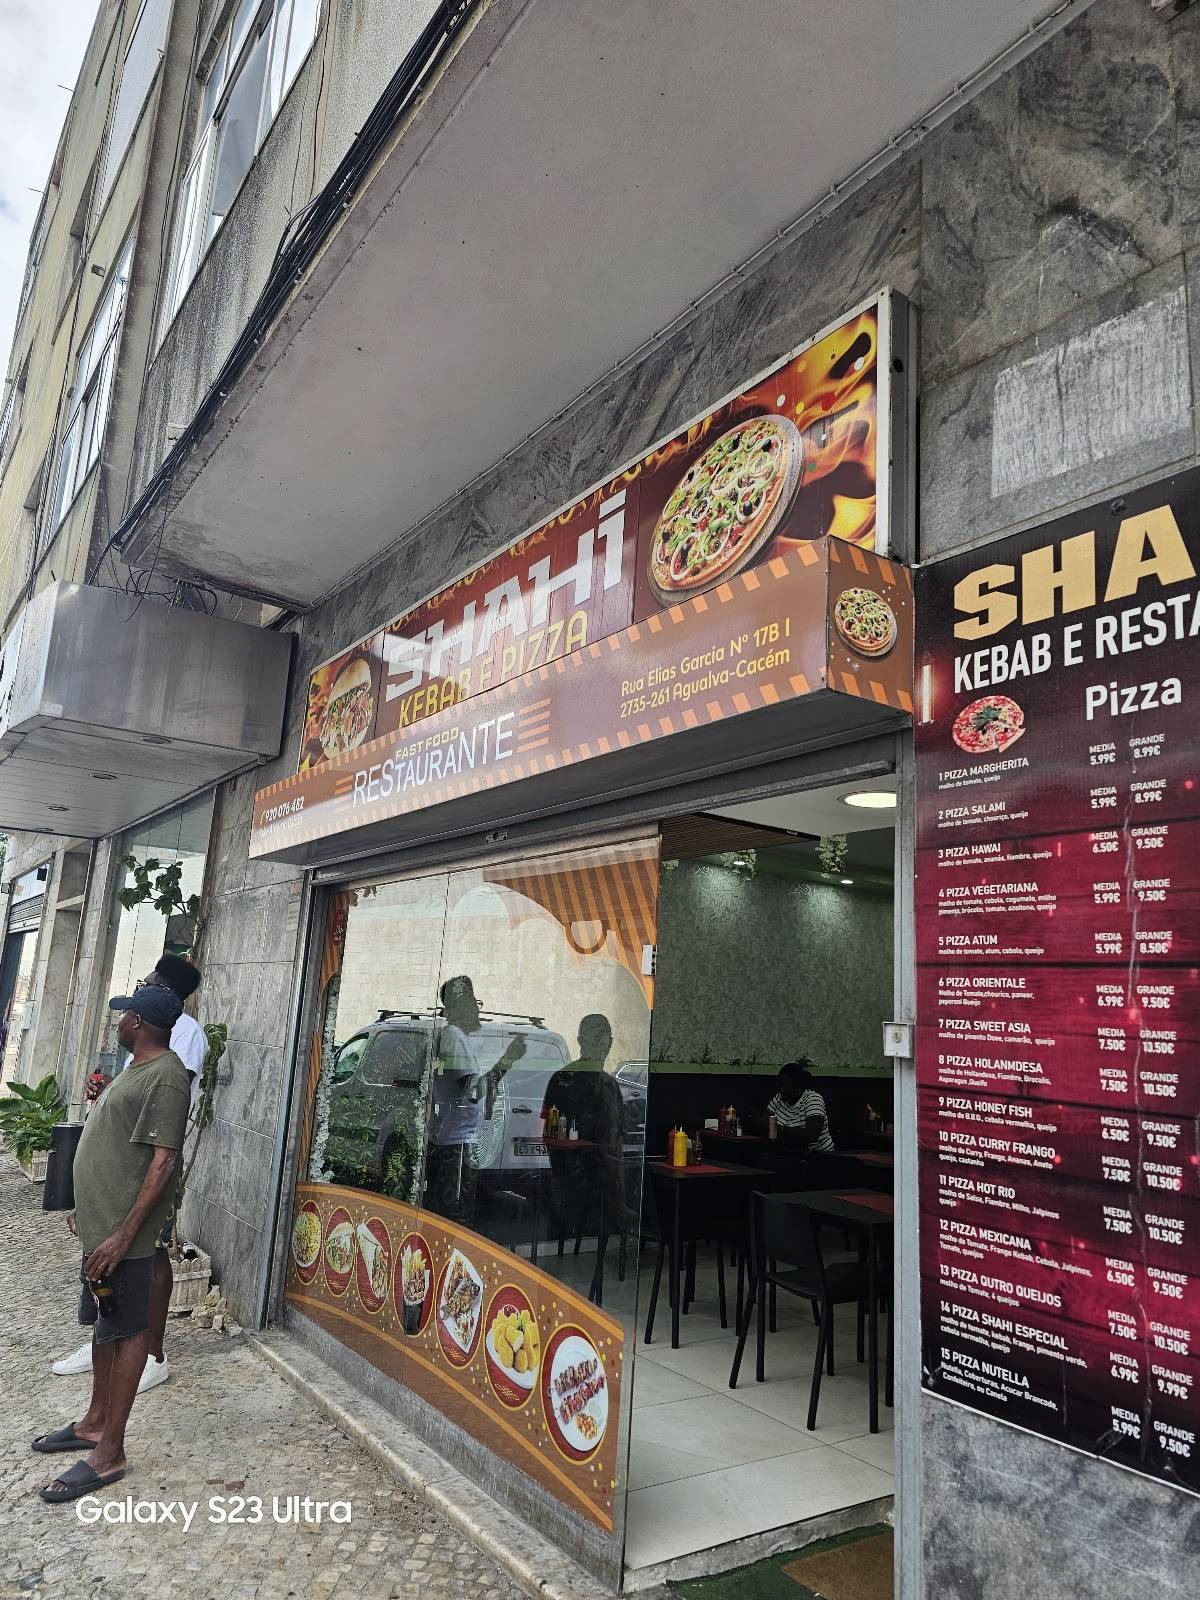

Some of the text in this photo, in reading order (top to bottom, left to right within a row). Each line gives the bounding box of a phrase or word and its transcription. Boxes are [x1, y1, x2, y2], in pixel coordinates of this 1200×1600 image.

[953, 504, 1196, 641] SHA
[501, 610, 587, 681] PIZZA
[622, 679, 643, 696] Rua
[648, 664, 676, 687] Elias
[681, 647, 725, 674] Garcia
[753, 622, 778, 647] 17B
[954, 632, 1051, 694] KEBAB
[1064, 622, 1083, 667] E
[620, 649, 790, 718] 2735-261 Agualva-Cacém
[1086, 676, 1182, 721] Pizza
[396, 727, 458, 761] FAST FOOD
[1089, 734, 1165, 753] MEDIA GRANDE
[352, 712, 514, 808] RESTAURANTE
[1090, 745, 1160, 765] 5.99€ 8.99€
[939, 758, 1029, 781] 1 PIZZA MARGHERITA
[1090, 779, 1166, 797] MEDIA GRANDE
[266, 796, 304, 822] 920 076 482
[939, 802, 1005, 819] 2 PIZZA SALAMI
[1091, 791, 1162, 808] 5.99€ 8.99€
[1092, 826, 1168, 840] MEDIA GRANDE
[938, 843, 1000, 858] 3 PIZZA HAWAI
[1093, 837, 1163, 853] 6.50€ 9.50€
[939, 882, 1038, 897] 4 PIZZA VEGETARIANA
[1093, 879, 1170, 891] MEDIA GRANDE
[1094, 890, 1166, 903] 5.99€ 9.50€
[939, 935, 998, 945] 5 PIZZA ATUM
[1095, 931, 1172, 941] MEDIA GRANDE
[1096, 943, 1168, 953] 5.99€ 8.50€
[939, 978, 1026, 988] 6 PIZZA ORIENTALE
[1096, 985, 1174, 995] MEDIA GRANDE
[1098, 996, 1170, 1008] 6.99€ 9.50€
[939, 1019, 1031, 1033] 7 PIZZA SWEET ASIA
[1098, 1028, 1177, 1040] MEDIA GRANDE
[1099, 1039, 1174, 1054] 7.50€ 10.50€
[939, 1055, 944, 1064] 8
[947, 1055, 972, 1067] PIZZA
[1099, 1068, 1179, 1083] MEDIA GRANDE
[1100, 1079, 1176, 1097] 7.50€ 10.50€
[939, 1097, 1032, 1118] 9 PIZZA HONEY FISH
[1101, 1116, 1181, 1134] MEDIA GRANDE
[939, 1131, 1055, 1158] 10 PIZZA CURRY FRANGO
[1102, 1128, 1176, 1148] 6.50€ 9.50€
[1102, 1156, 1183, 1176] MEDIA GRANDE
[939, 1175, 1015, 1199] 11 PIZZA HOT RIO
[1103, 1167, 1180, 1191] 7.50€ 10.50€
[1103, 1206, 1185, 1230] MEDIA GRANDE
[940, 1219, 1031, 1250] 12 PIZZA MEXICANA
[1104, 1217, 1182, 1244] 7.50€ 10.50€
[1105, 1258, 1187, 1285] MEDIA GRANDE
[940, 1264, 1061, 1307] 13 PIZZA QUTRO QUEIJOS
[1107, 1270, 1183, 1299] 6.50€ 9.50€
[940, 1301, 1068, 1350] 14 PIZZA SHAHI ESPECIAL
[1108, 1310, 1191, 1341] MEDIA GRANDE
[1109, 1322, 1188, 1355] 7.50€ 10.50€
[941, 1347, 1029, 1388] 15 PIZZA NUTELLA
[1110, 1352, 1193, 1385] MEDIA GRANDE
[1111, 1365, 1188, 1400] 6.99€ 9.99€
[1111, 1406, 1195, 1443] MEDIA GRANDE
[1112, 1419, 1190, 1457] 5.99€ 9.50€
